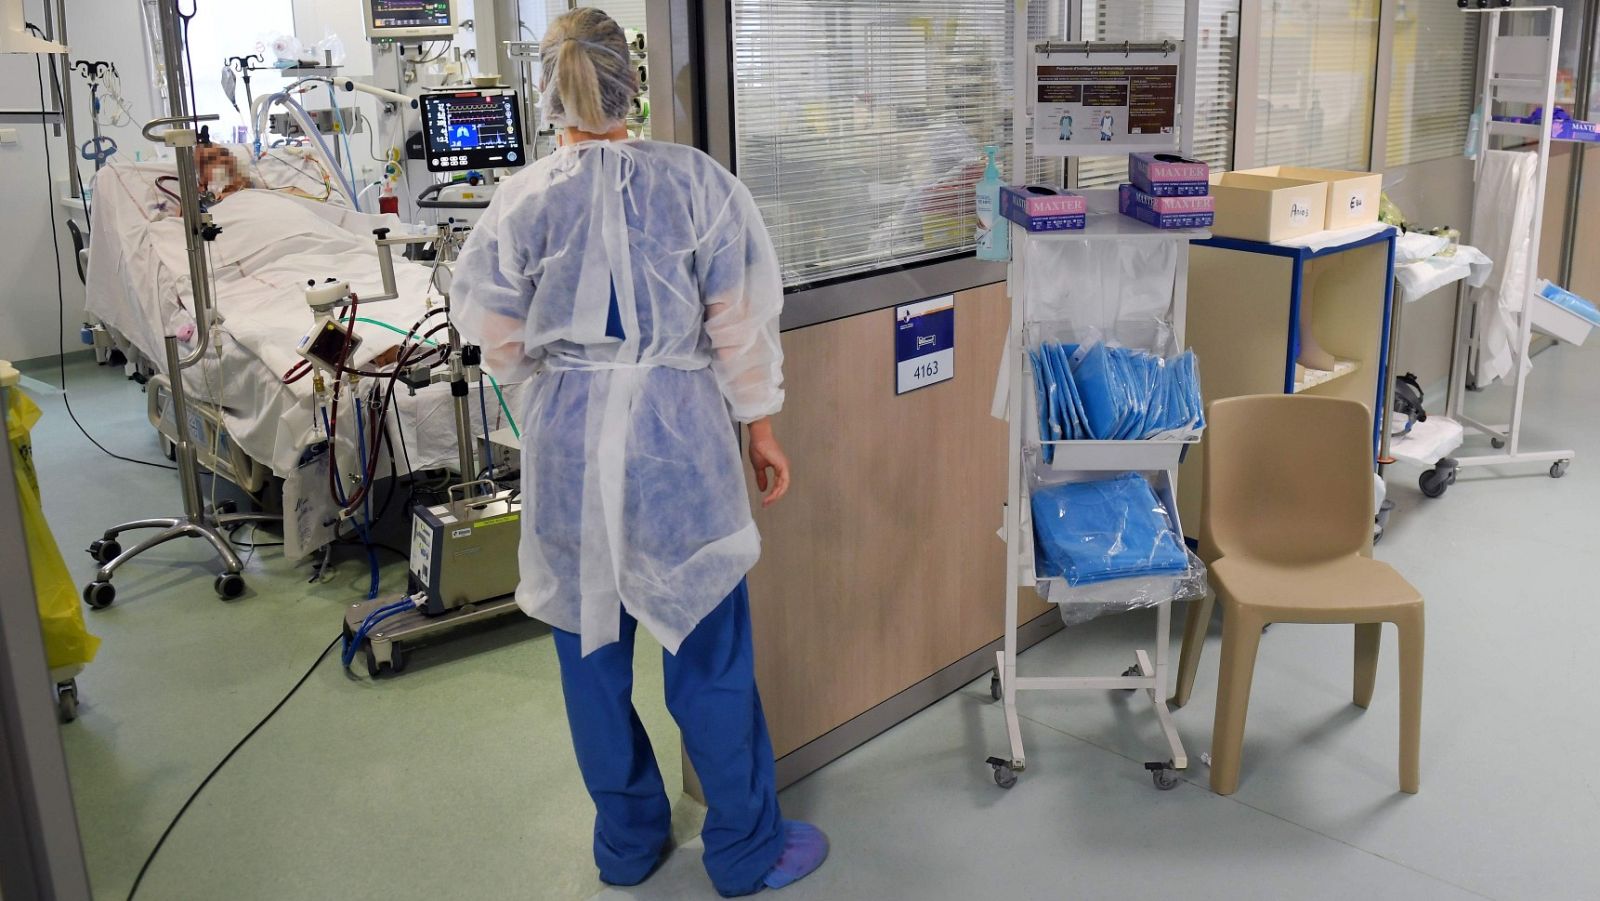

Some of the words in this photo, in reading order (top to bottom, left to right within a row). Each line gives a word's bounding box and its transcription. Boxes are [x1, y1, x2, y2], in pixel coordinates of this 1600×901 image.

[1154, 166, 1205, 178] MAXTER
[1033, 200, 1083, 212] MAXTER
[1164, 199, 1210, 209] MAXTER
[913, 361, 939, 380] 4163
